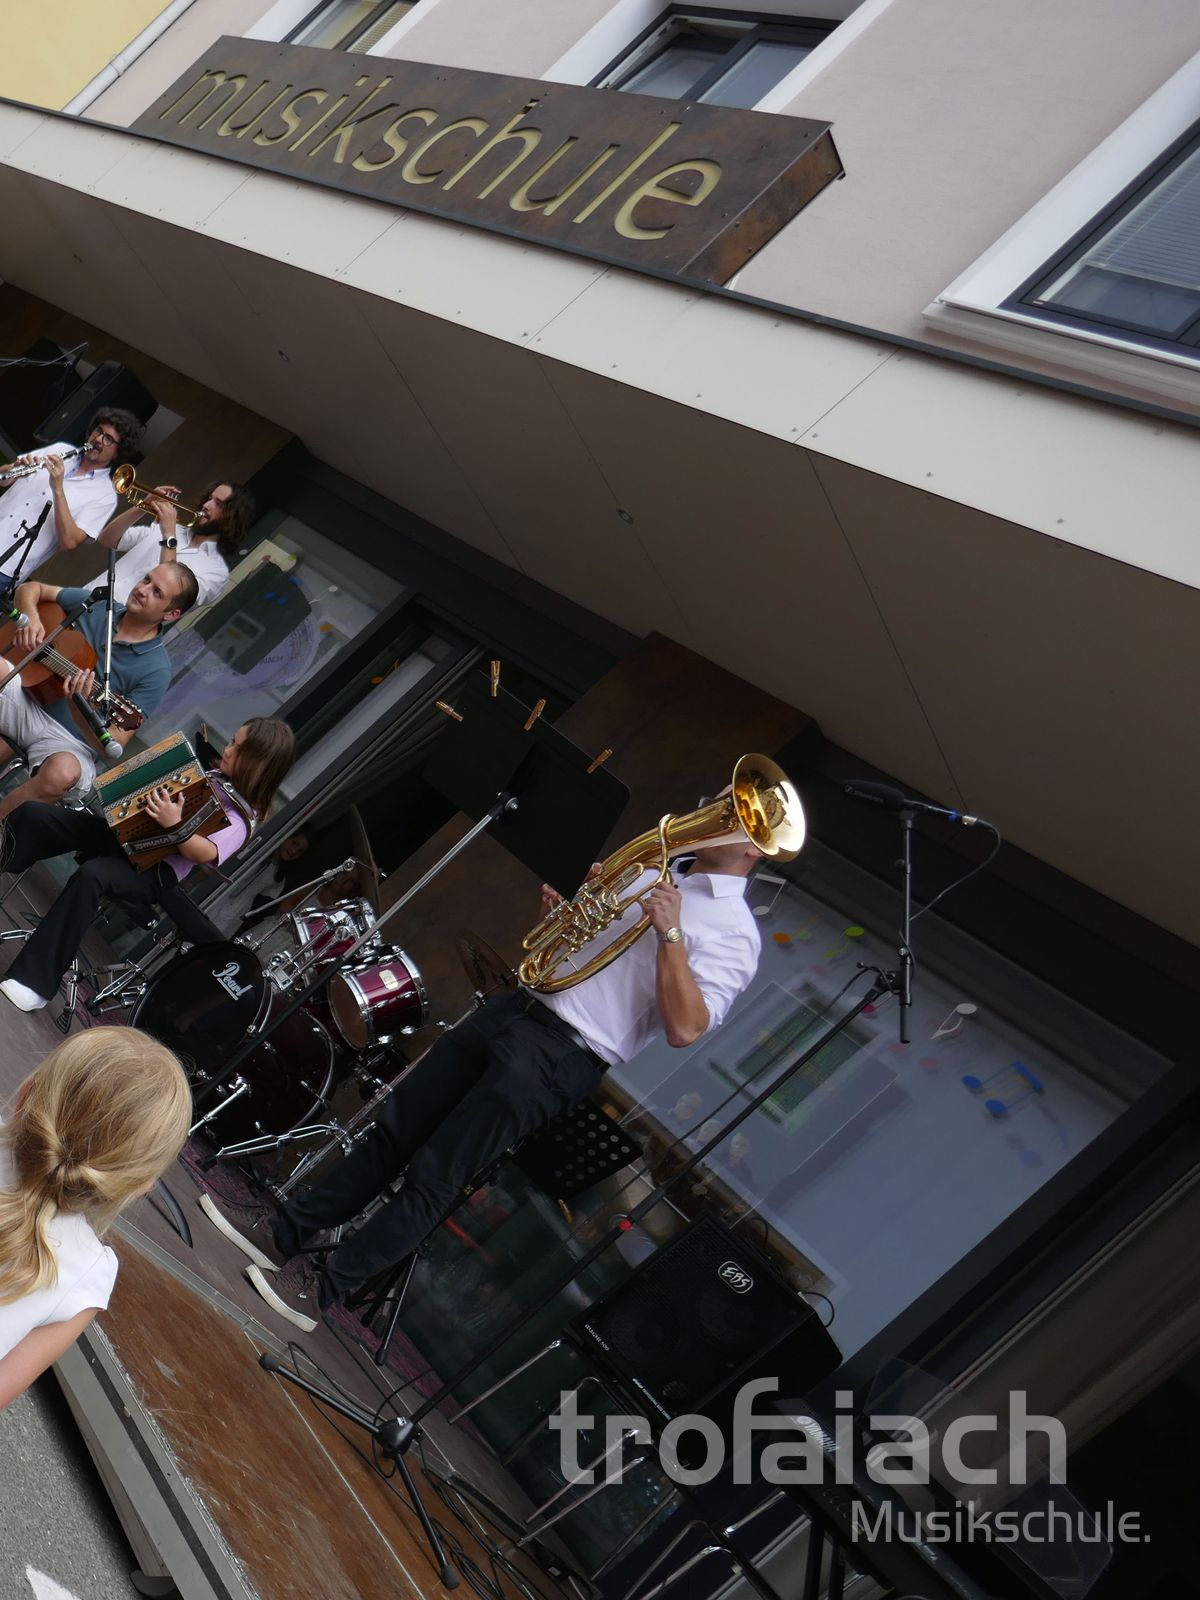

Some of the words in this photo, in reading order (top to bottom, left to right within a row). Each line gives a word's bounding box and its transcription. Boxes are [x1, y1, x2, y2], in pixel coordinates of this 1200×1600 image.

[159, 70, 722, 241] musikschule
[212, 962, 253, 998] Pearl
[721, 1267, 750, 1287] EBS
[804, 1420, 839, 1452] YAMAHA
